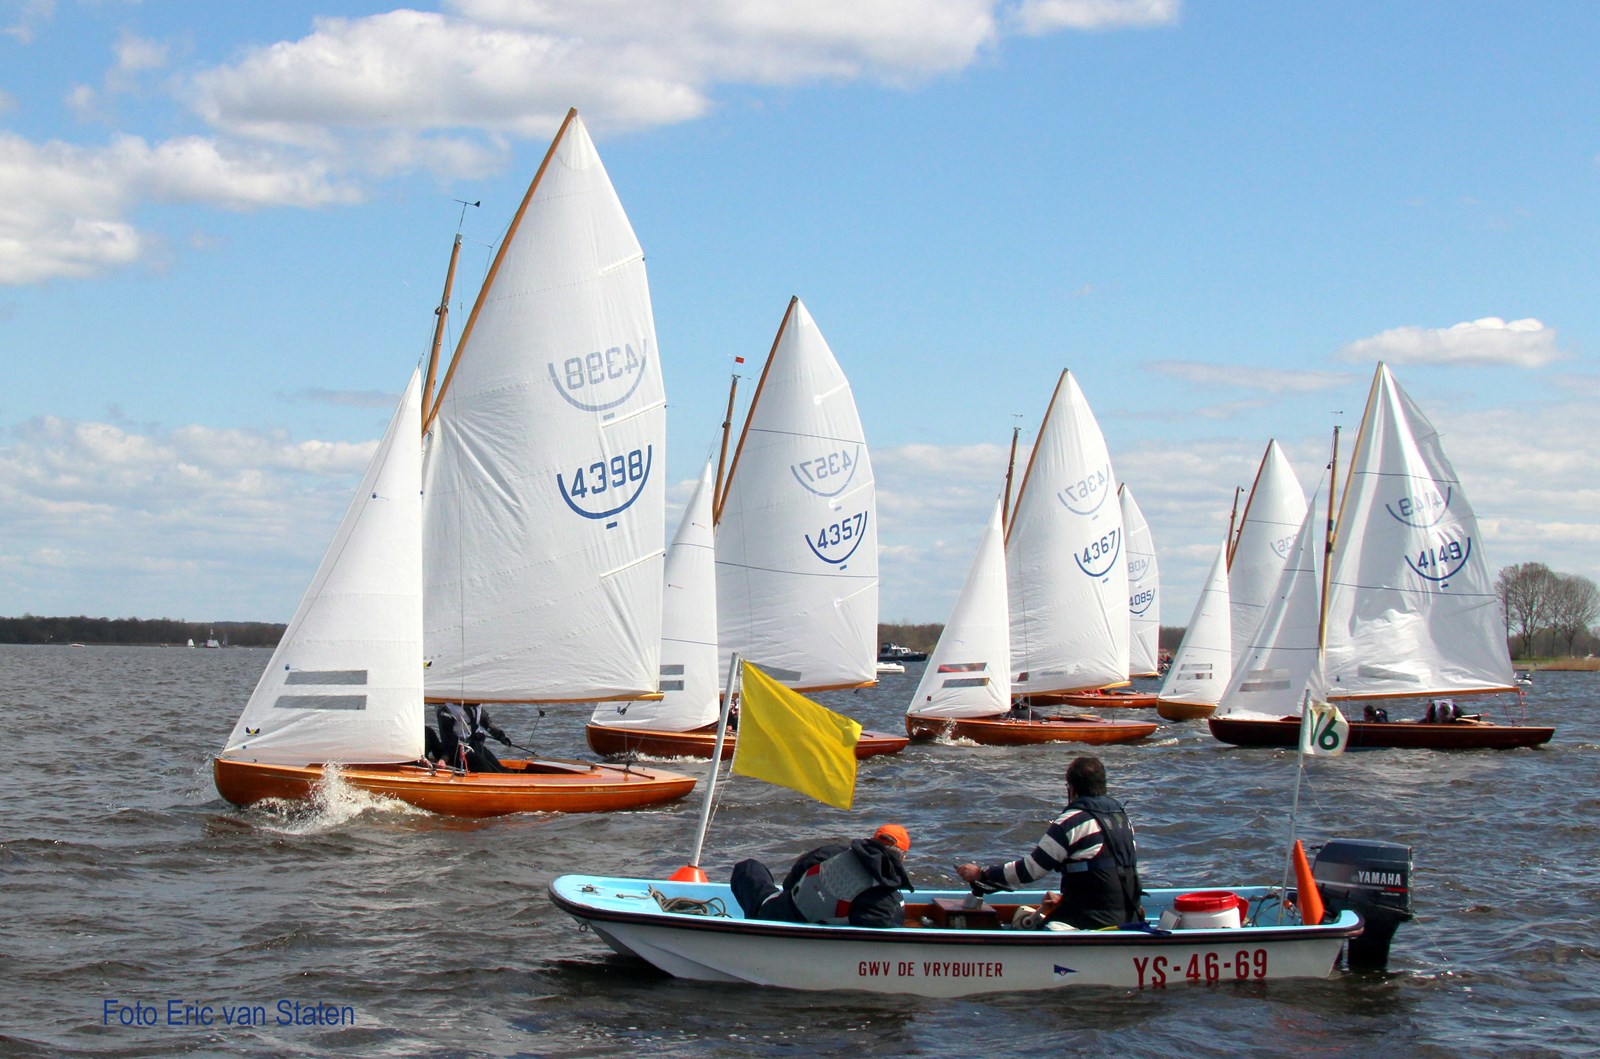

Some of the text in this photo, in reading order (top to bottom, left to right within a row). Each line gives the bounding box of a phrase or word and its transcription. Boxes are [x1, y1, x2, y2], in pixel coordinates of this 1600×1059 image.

[571, 449, 643, 498] 4398
[817, 512, 863, 549] 4357
[1082, 530, 1116, 564] 4367
[1418, 541, 1462, 569] 4149
[1129, 589, 1152, 606] 4085
[1358, 870, 1402, 886] YAMAHA
[858, 961, 1003, 978] GWV DE VRYBUITER
[1133, 948, 1268, 989] YS-46-69
